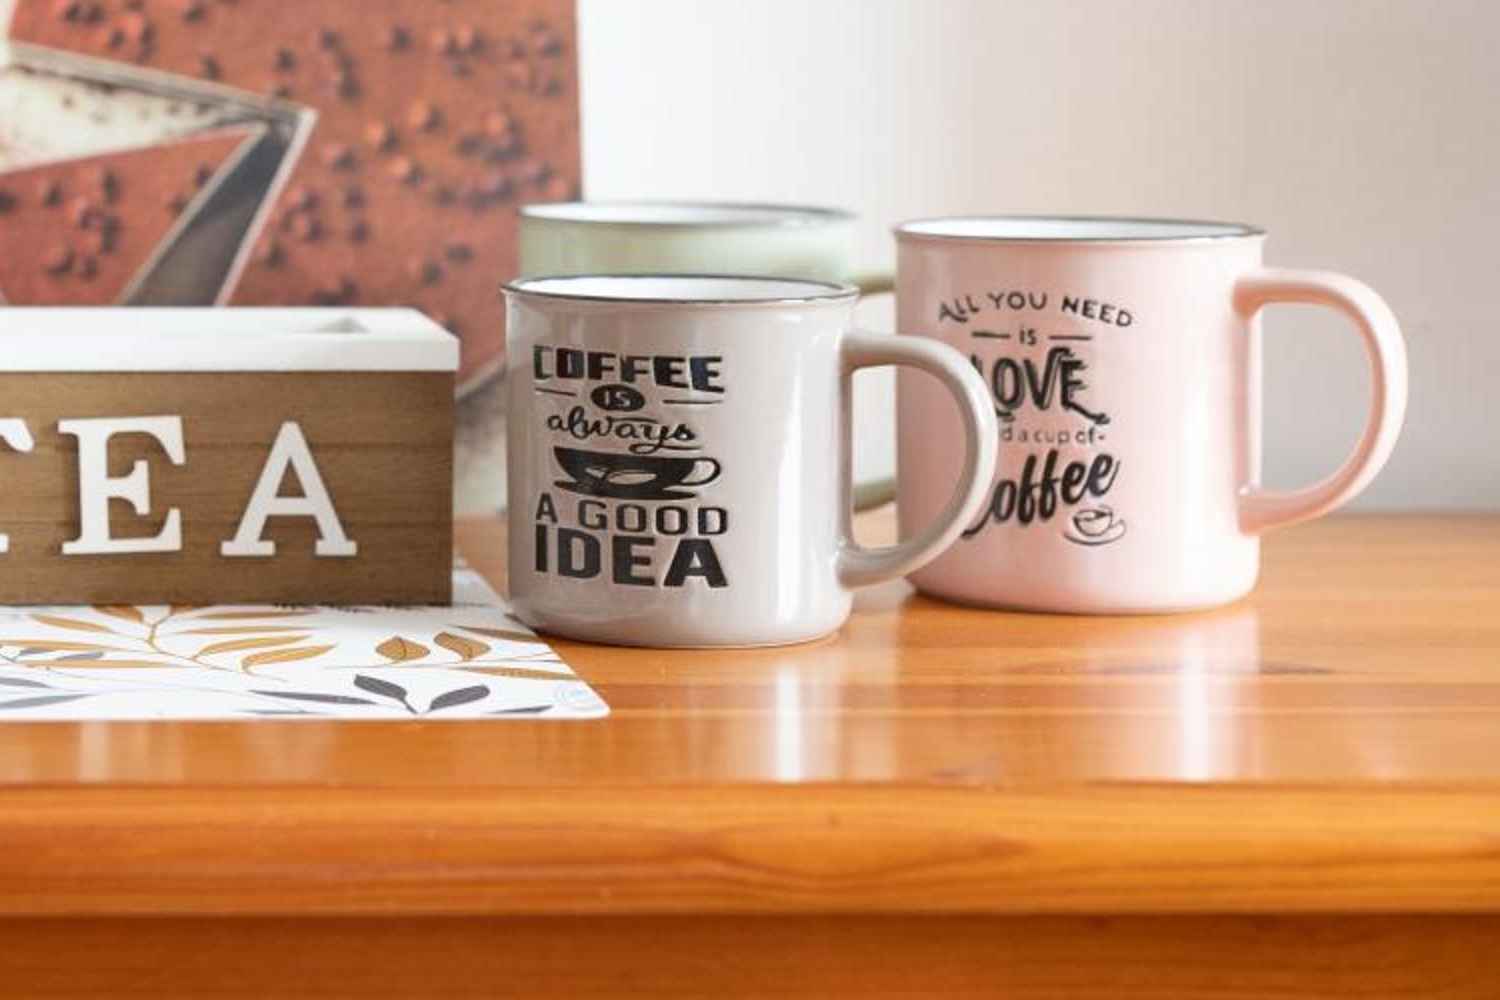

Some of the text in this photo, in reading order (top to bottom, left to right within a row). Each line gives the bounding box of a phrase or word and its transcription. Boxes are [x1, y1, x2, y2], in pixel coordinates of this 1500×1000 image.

[938, 291, 1134, 328] ALL YOU NEED
[533, 344, 726, 393] COFFEE
[603, 388, 633, 403] IS
[546, 405, 705, 455] always
[1033, 429, 1070, 446] cup
[536, 492, 729, 536] A GOOD
[961, 448, 1121, 537] offee
[535, 524, 730, 588] IDEA
